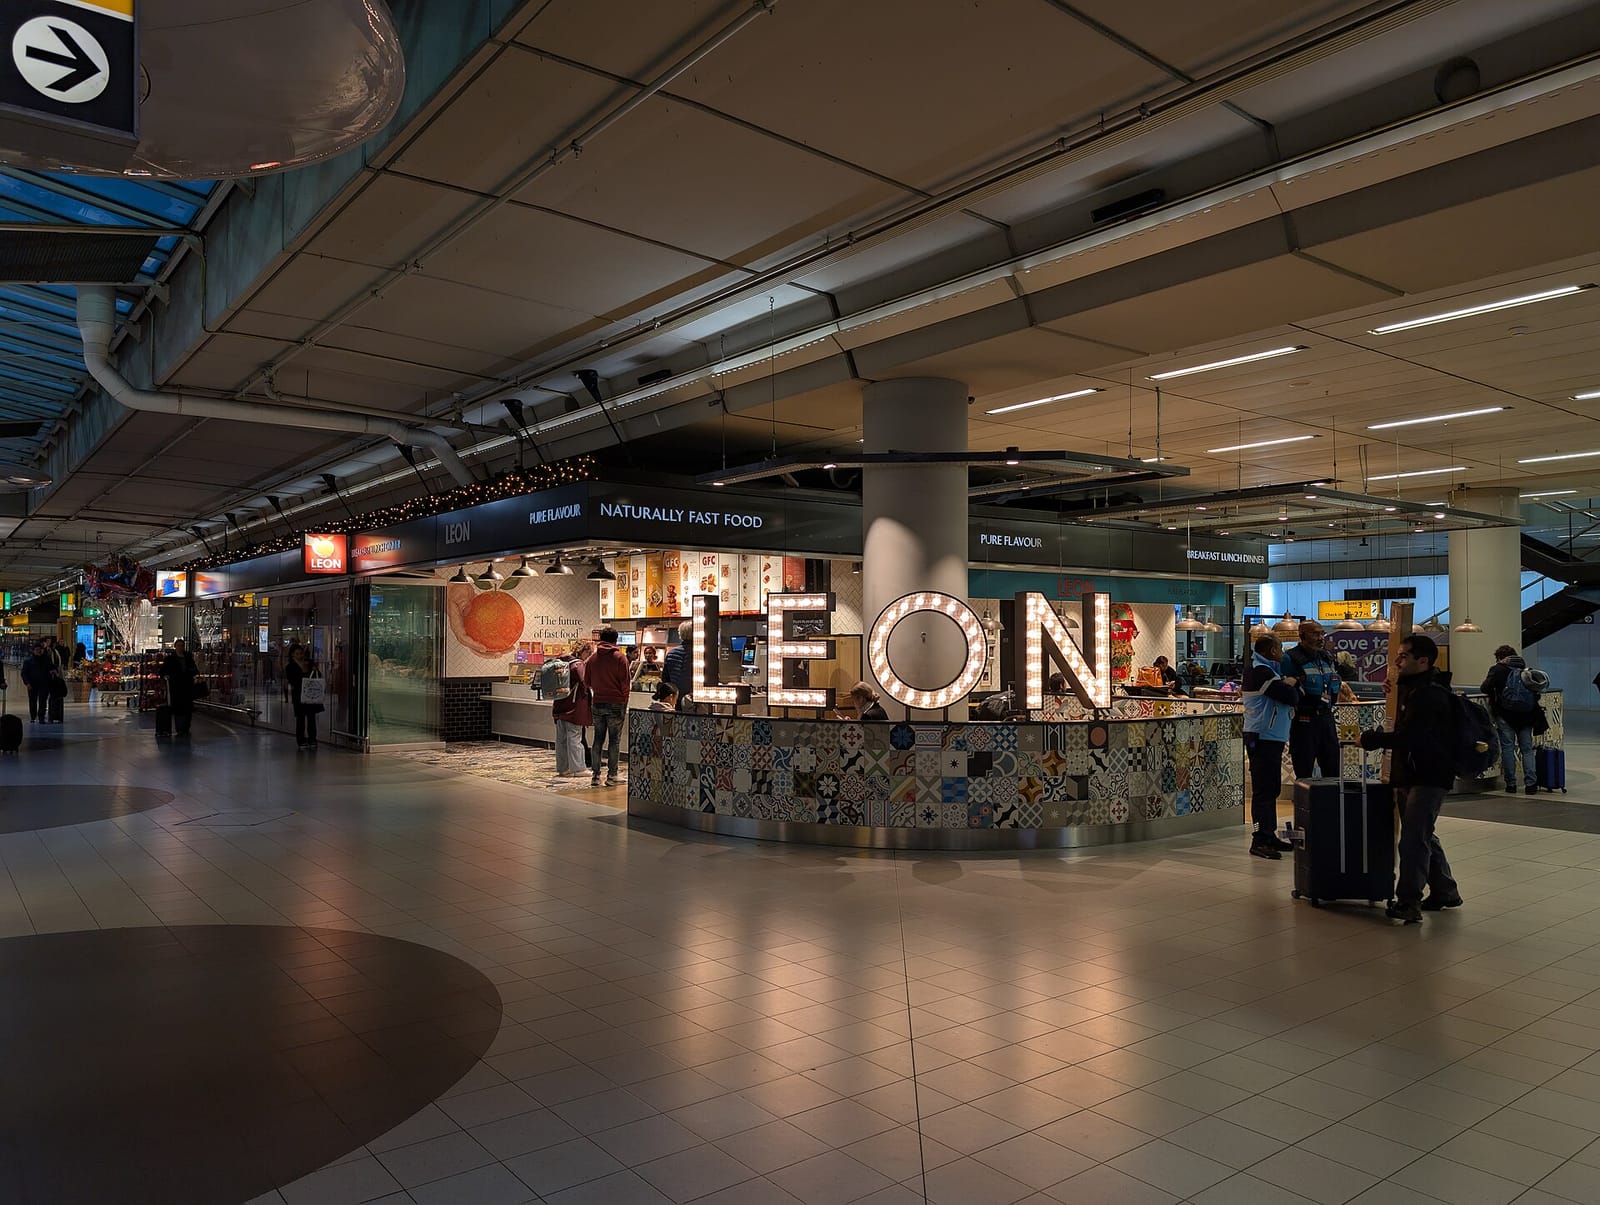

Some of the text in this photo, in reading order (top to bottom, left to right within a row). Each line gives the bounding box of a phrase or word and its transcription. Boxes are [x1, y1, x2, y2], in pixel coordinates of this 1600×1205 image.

[529, 503, 581, 525] PURE FLAVOUR
[600, 502, 764, 529] NATURALLY FAST FOOD
[445, 520, 471, 545] LEON
[980, 533, 1043, 548] PURE FLAVOUR
[311, 558, 342, 569] LEON
[702, 555, 716, 566] GFC
[1186, 550, 1265, 564] BREAKFAST LUNCH DINNER
[558, 615, 583, 626] future
[533, 628, 544, 639] of
[544, 629, 559, 639] fast
[692, 591, 1112, 711] LEON
